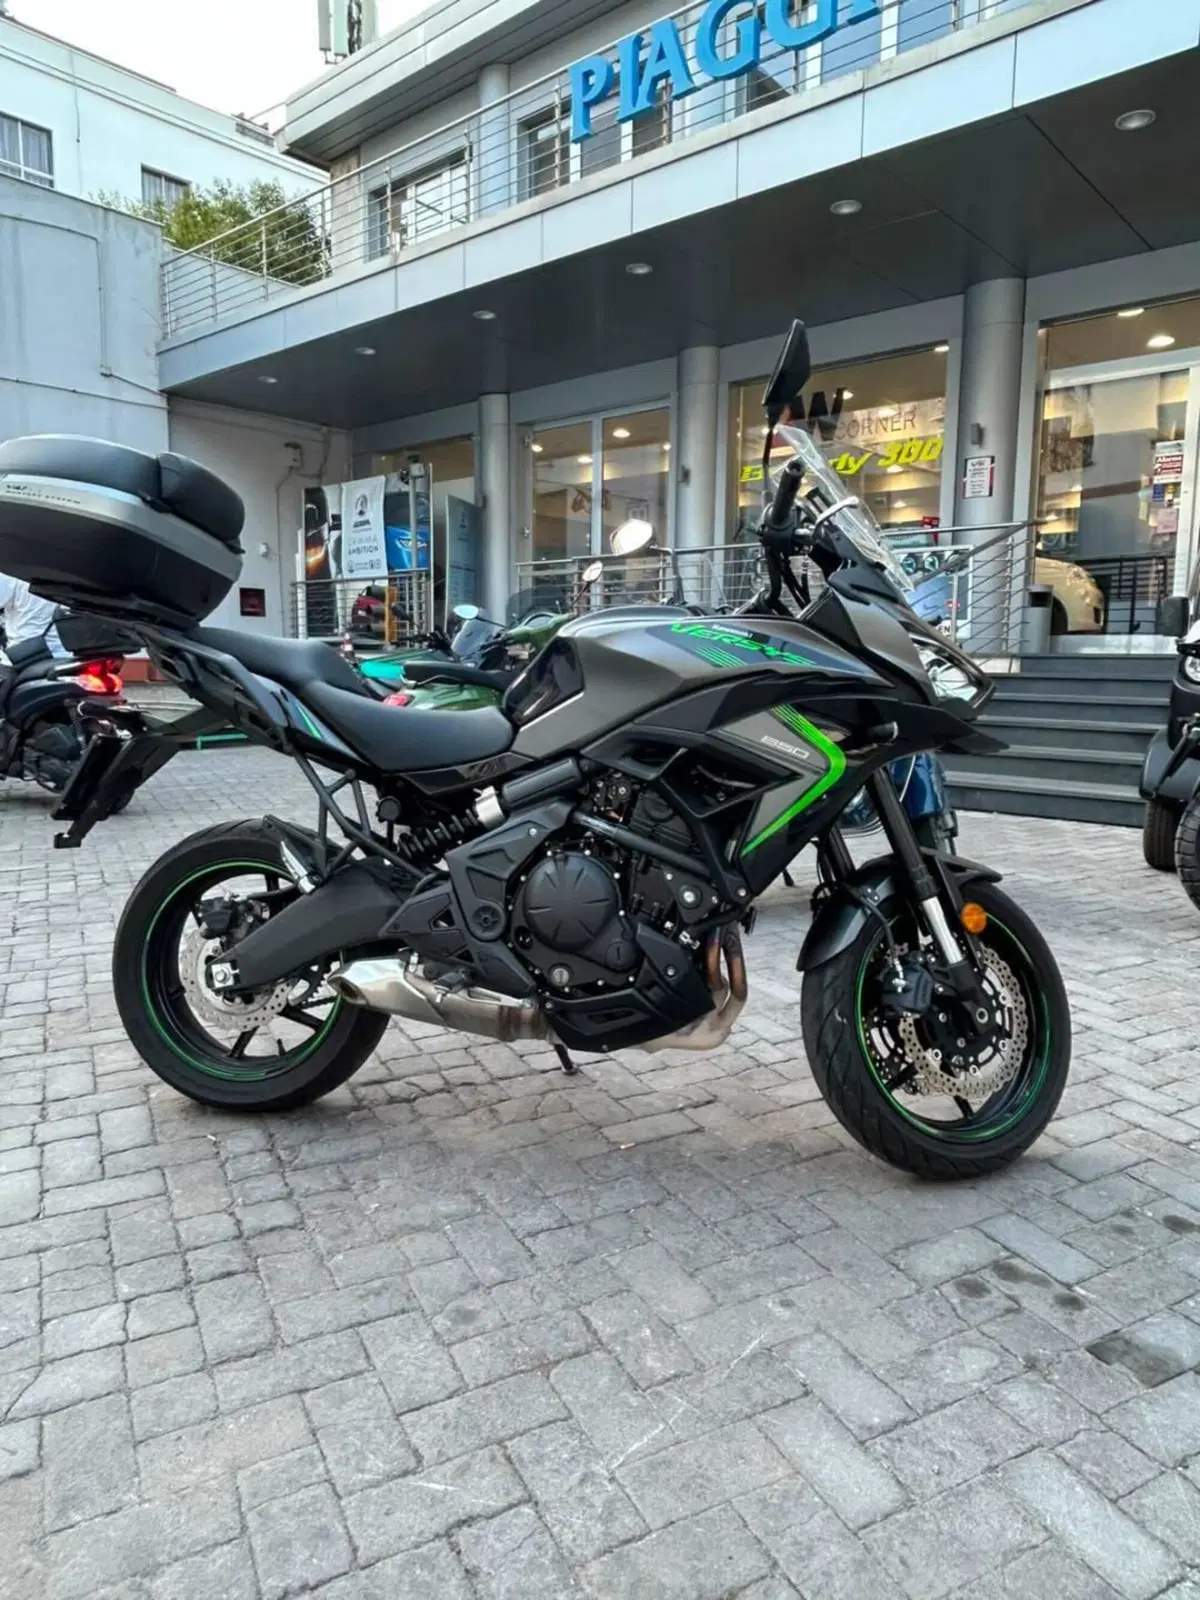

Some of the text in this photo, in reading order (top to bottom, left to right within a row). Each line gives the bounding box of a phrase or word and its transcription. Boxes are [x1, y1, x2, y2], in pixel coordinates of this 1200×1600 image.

[569, 0, 880, 143] PIAGG
[834, 406, 917, 440] CORNER
[760, 735, 811, 759] 650
